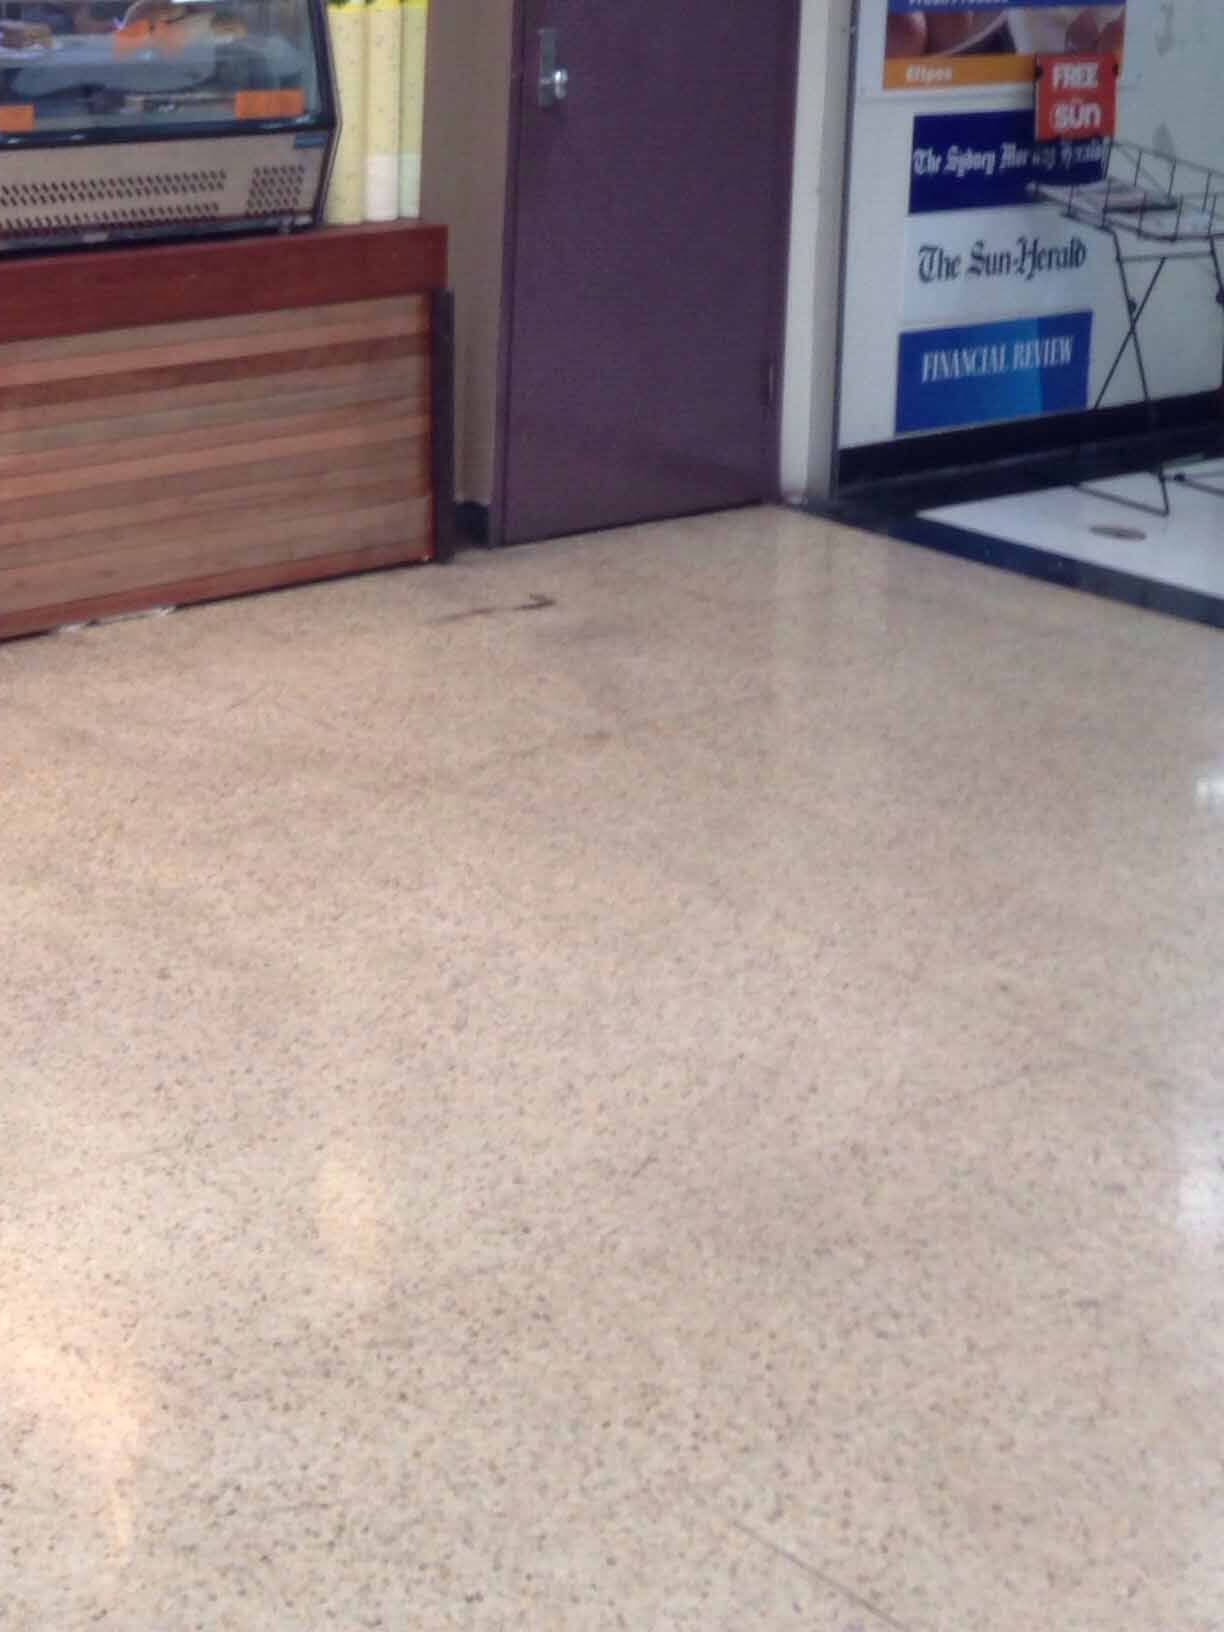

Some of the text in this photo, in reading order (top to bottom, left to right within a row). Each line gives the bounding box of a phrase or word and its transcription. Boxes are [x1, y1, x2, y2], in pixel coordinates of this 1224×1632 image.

[1051, 62, 1099, 88] FREE
[913, 146, 942, 176] The
[944, 144, 996, 178] Sydney
[918, 236, 1089, 284] The Sun-Herald
[921, 335, 1075, 384] FINANCIAL REVIEW
